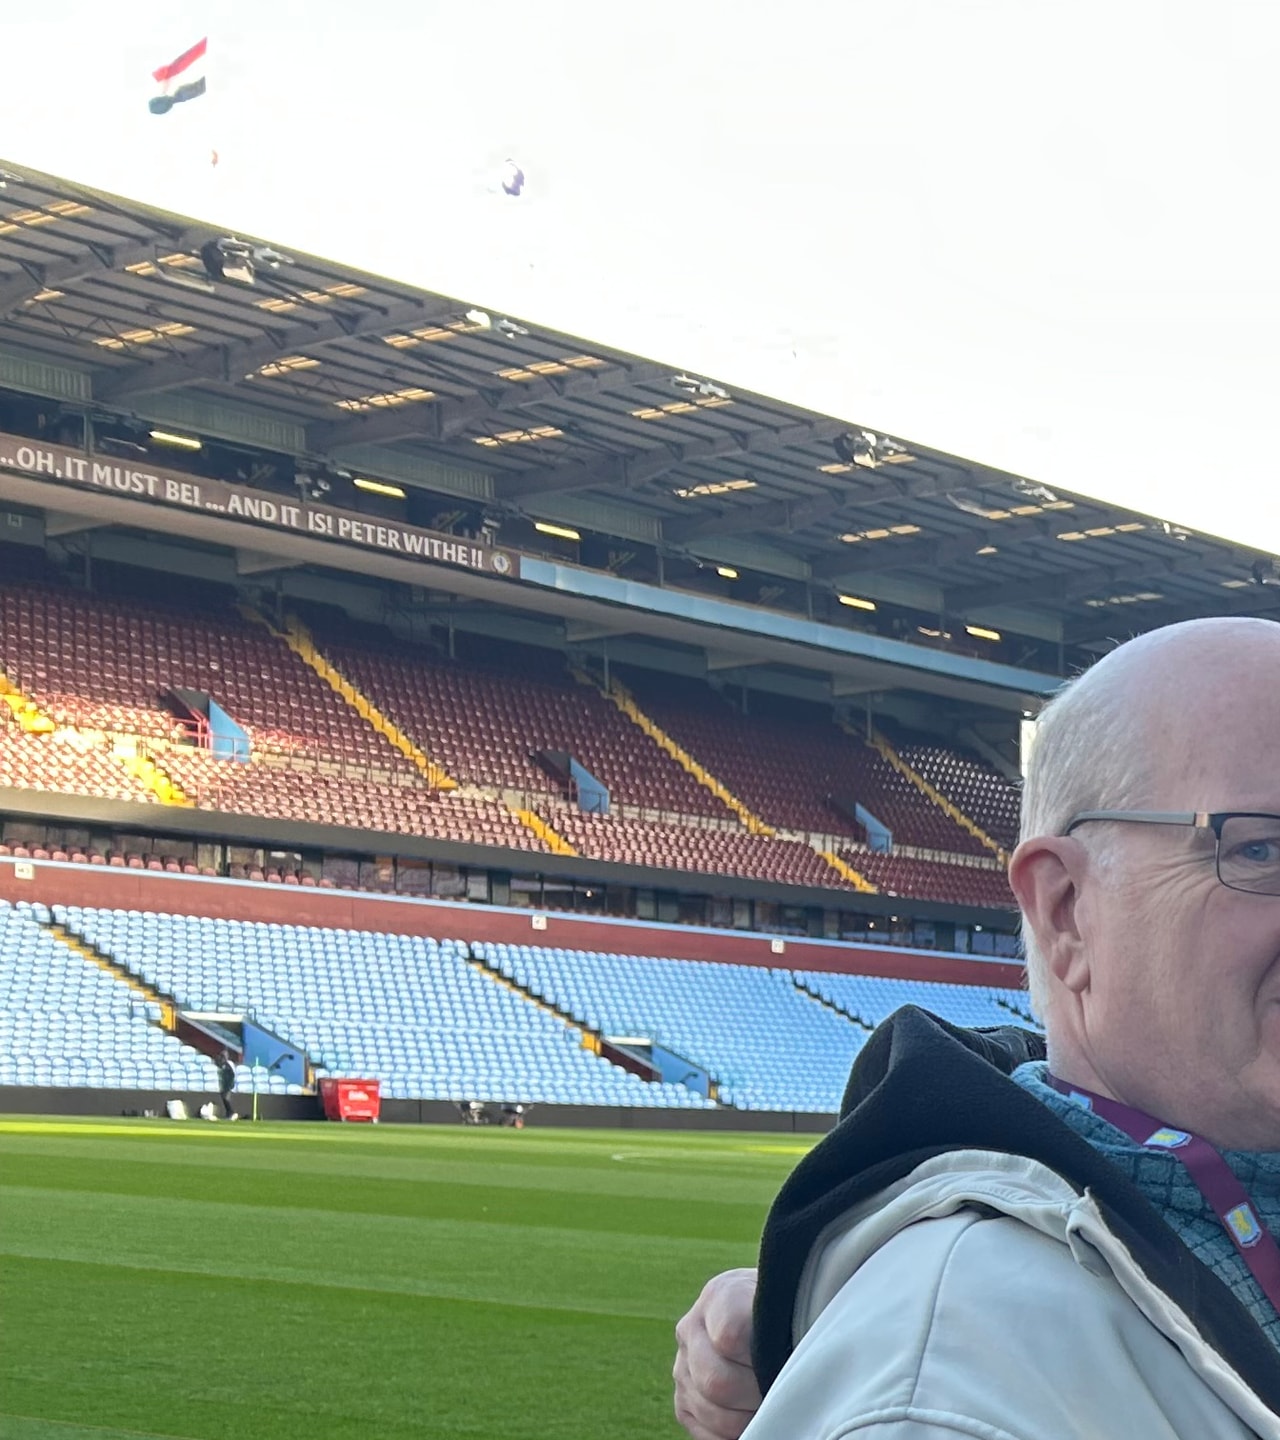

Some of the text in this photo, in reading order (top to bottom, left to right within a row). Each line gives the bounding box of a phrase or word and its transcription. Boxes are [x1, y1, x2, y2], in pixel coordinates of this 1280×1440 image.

[65, 456, 88, 481] IT
[93, 463, 158, 496] MUST
[281, 505, 300, 526] IT
[307, 511, 333, 534] IS!
[339, 517, 400, 550] PETER
